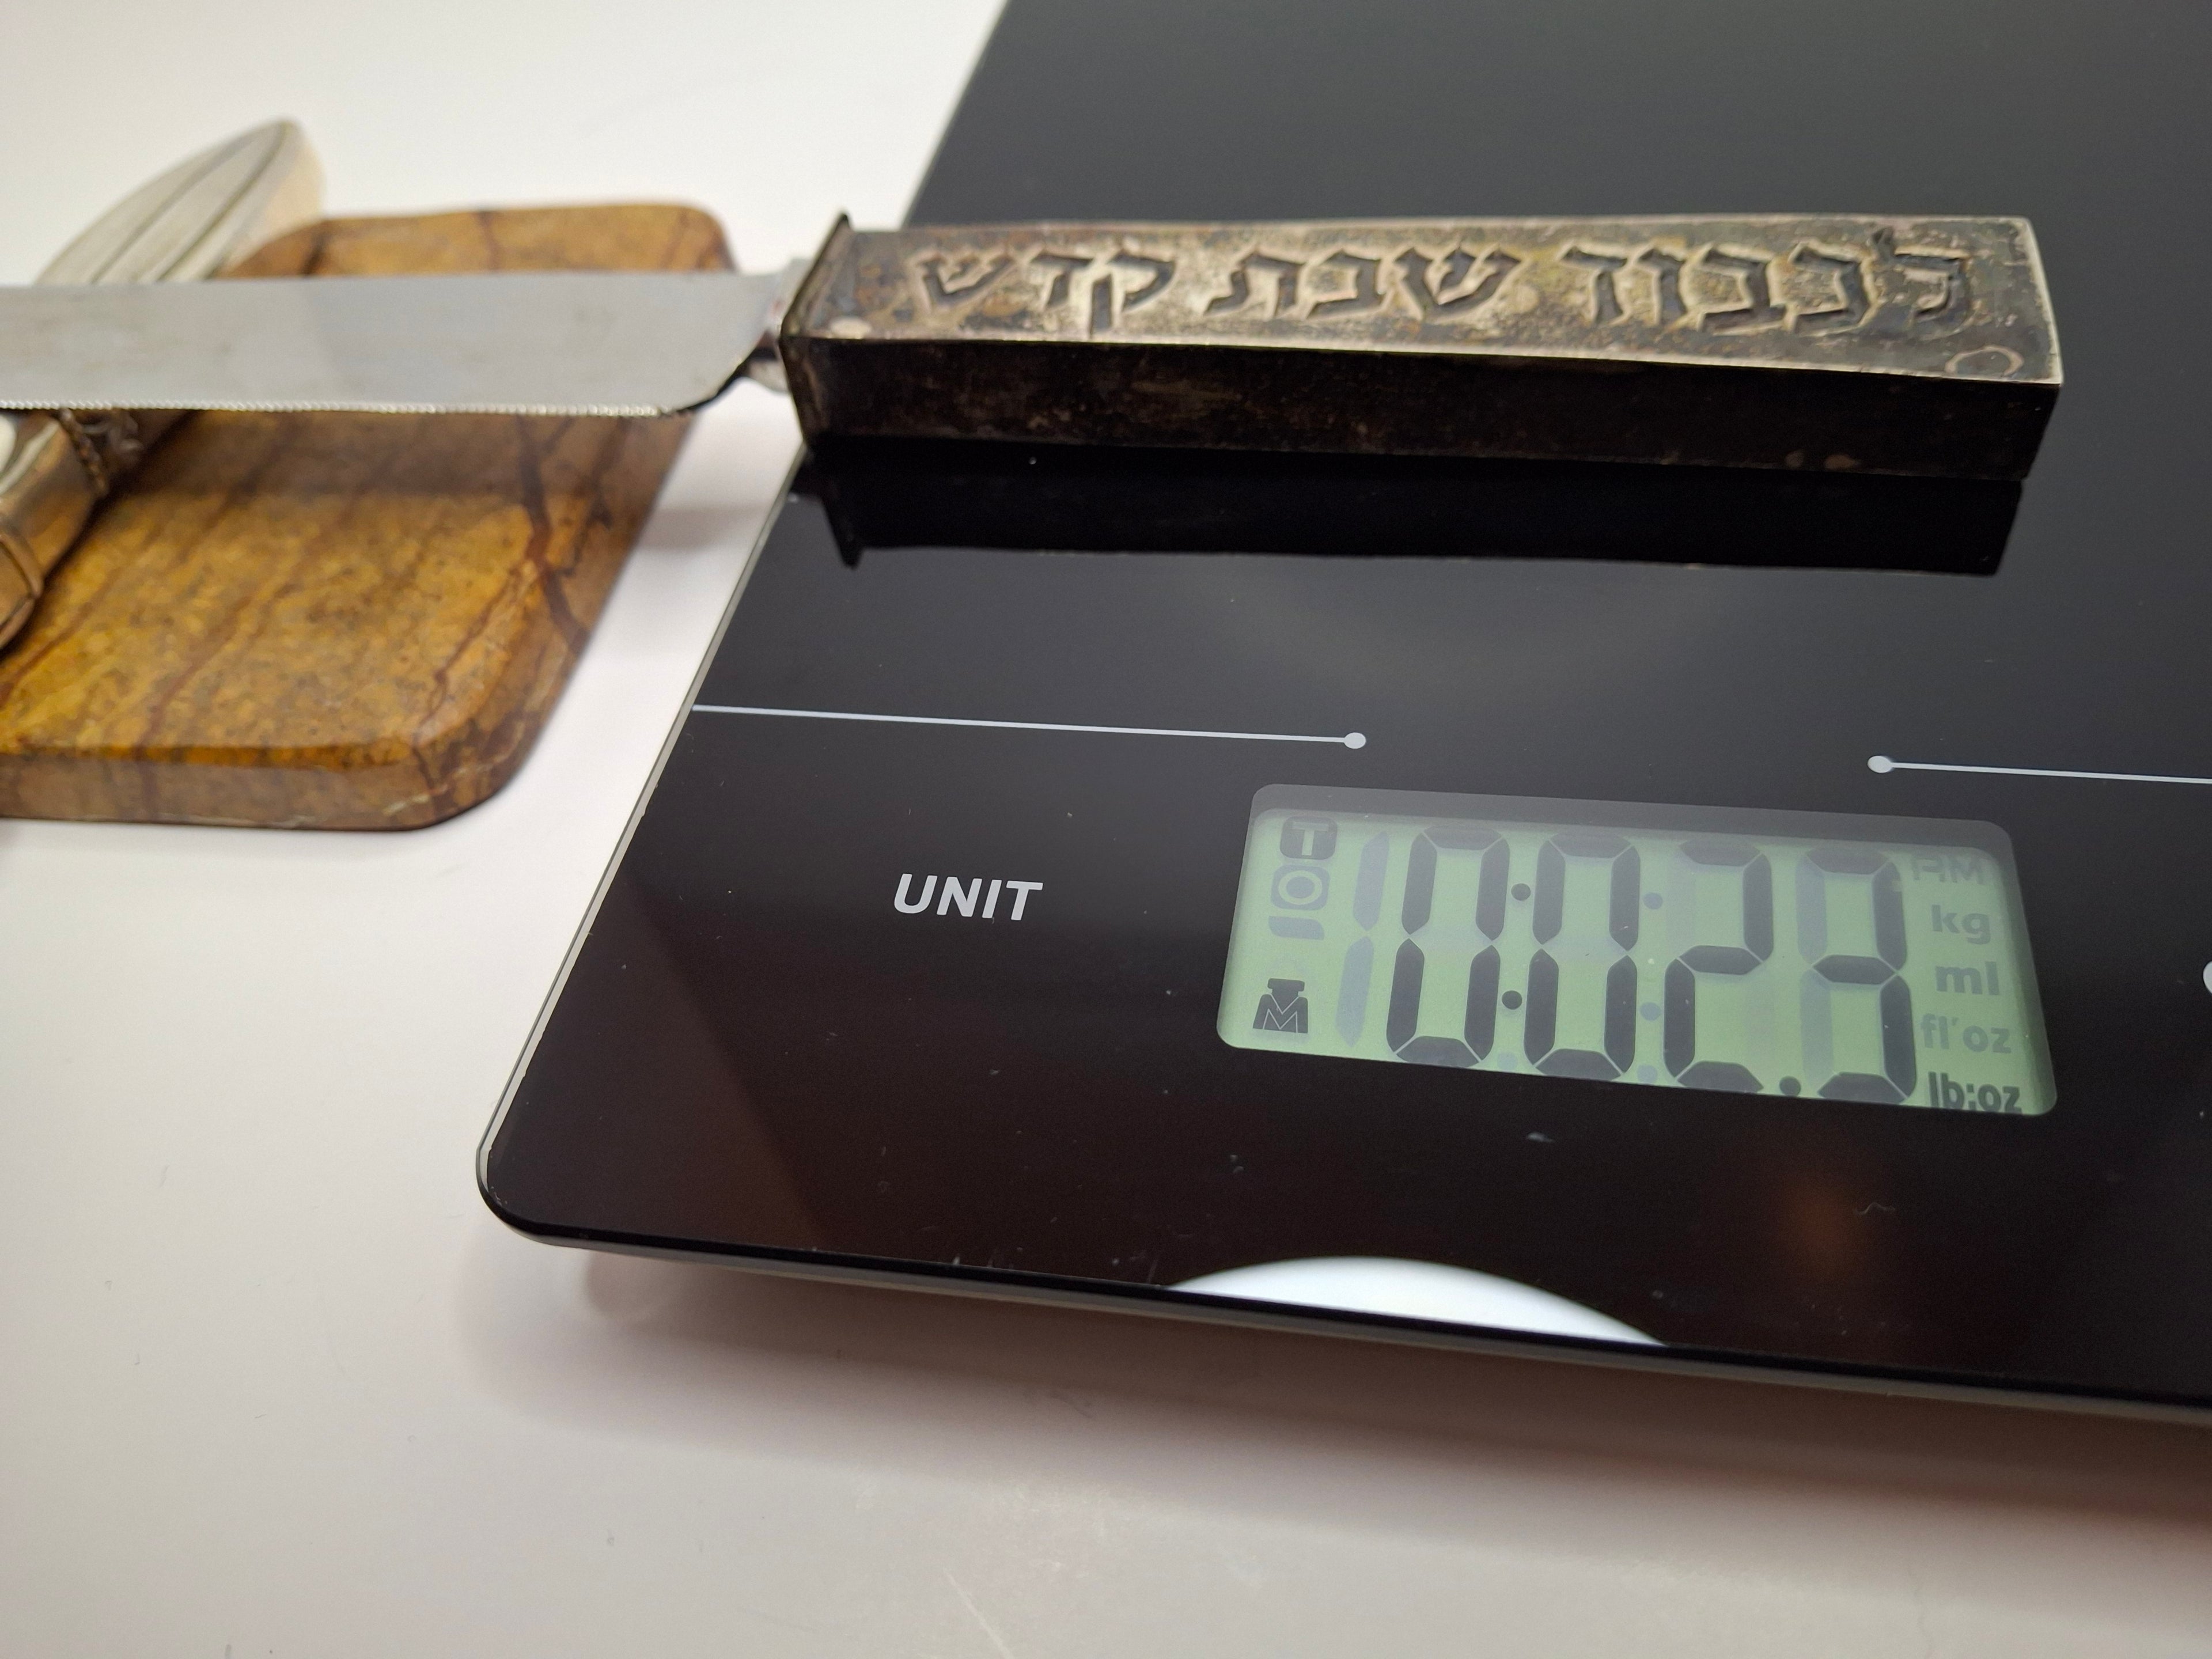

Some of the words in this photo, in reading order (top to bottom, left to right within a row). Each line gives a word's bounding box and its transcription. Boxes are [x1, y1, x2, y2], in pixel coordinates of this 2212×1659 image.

[916, 247, 1176, 339] קדש
[1203, 247, 1524, 320] שבת
[894, 873, 1043, 921] UNIT
[1931, 904, 1991, 945] kg
[1935, 961, 2000, 995] ml
[1927, 1071, 2022, 1114] lb:oz
